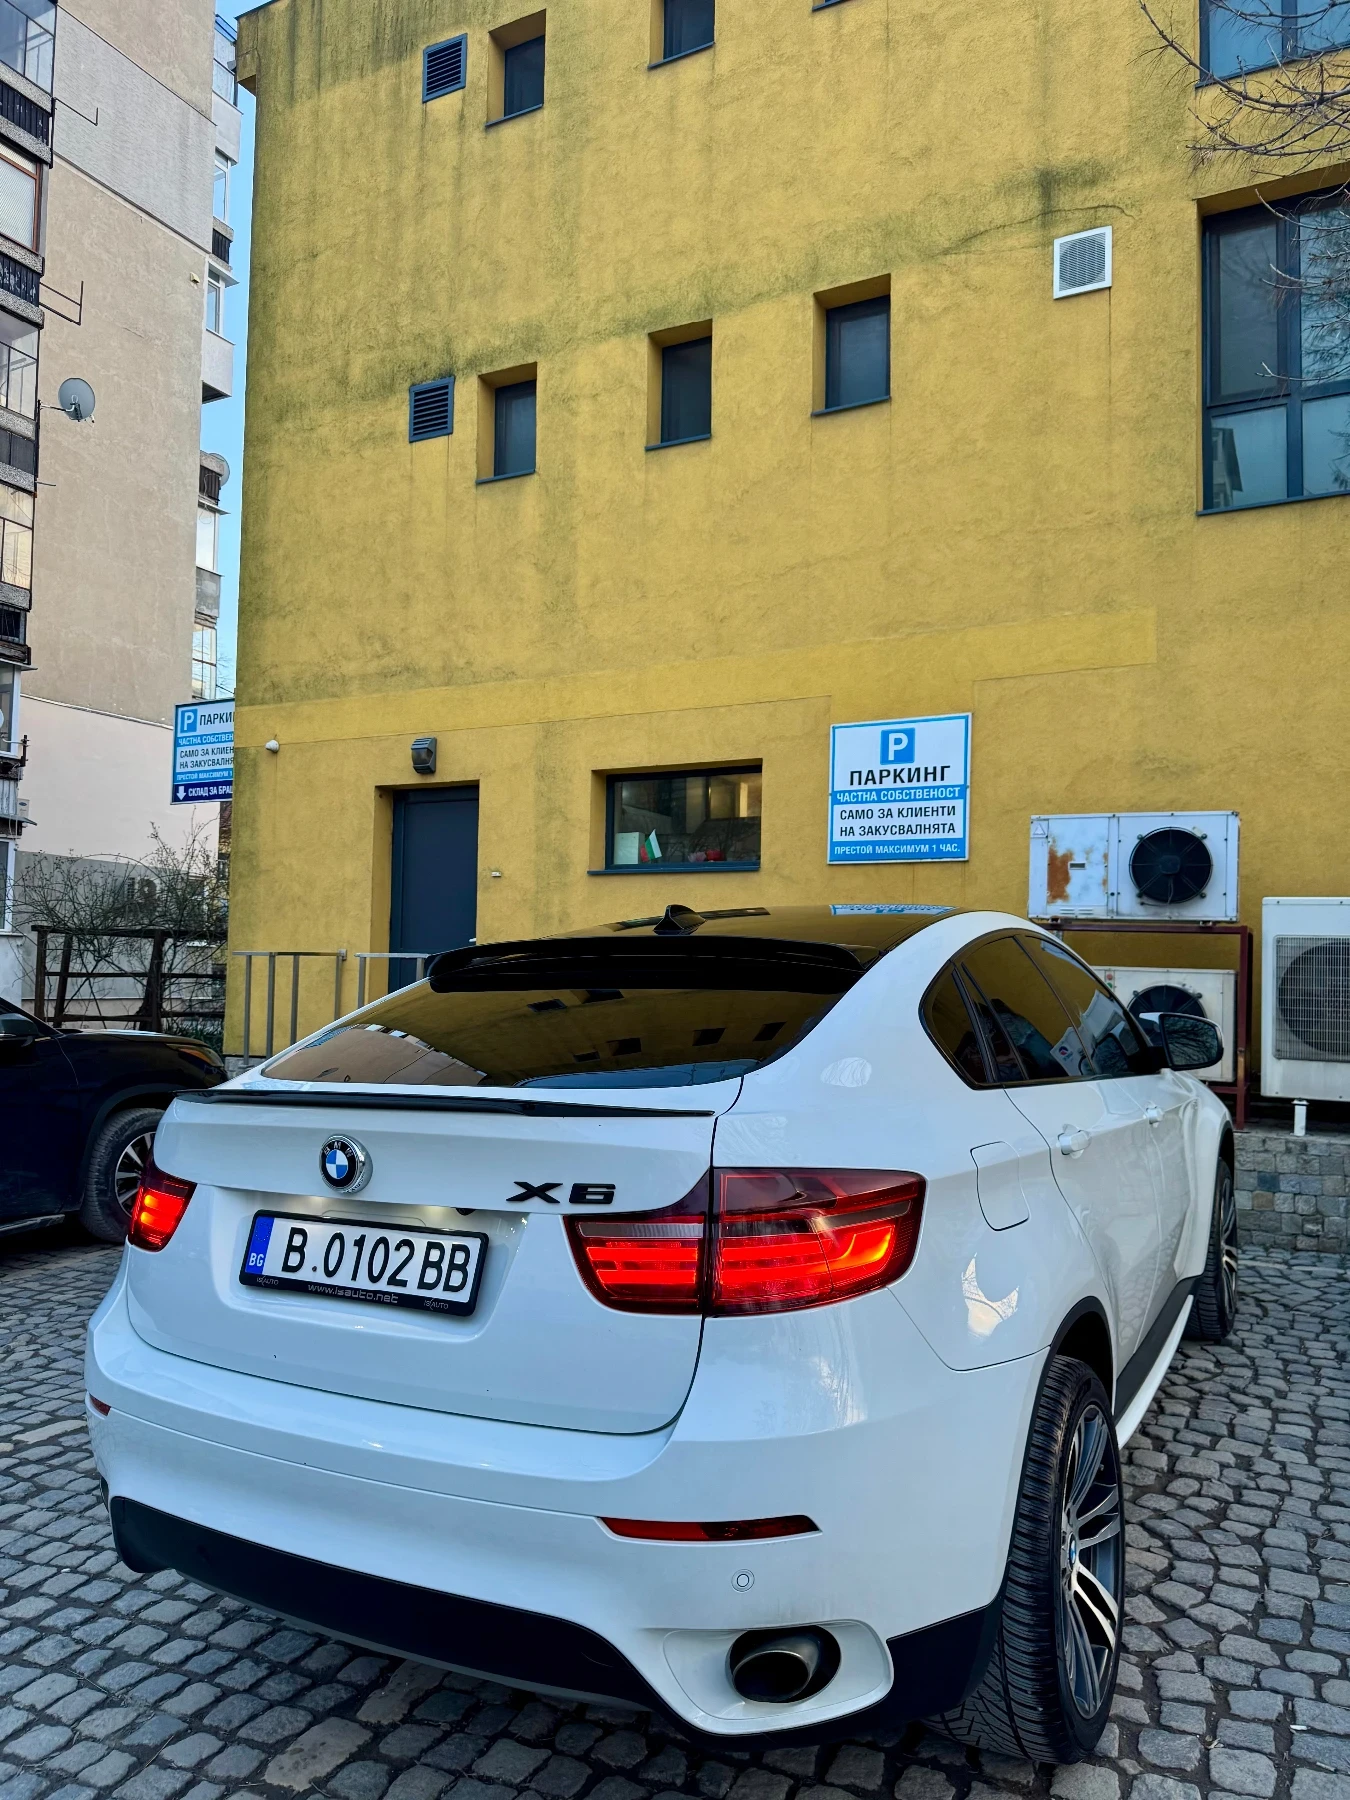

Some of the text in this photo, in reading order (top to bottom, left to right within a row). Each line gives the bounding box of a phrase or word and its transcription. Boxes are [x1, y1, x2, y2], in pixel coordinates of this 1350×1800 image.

[183, 711, 195, 731] P
[199, 711, 235, 726] ПАРКИ
[178, 736, 201, 746] ЧАСТНА
[888, 732, 909, 761] P
[180, 749, 199, 759] САМО
[200, 748, 210, 757] ЗА
[180, 760, 189, 770] НА
[849, 765, 951, 786] ПАРКИНГ
[188, 787, 209, 797] СКЛАД
[209, 786, 218, 795] ЗА
[836, 787, 961, 803] ЧАСТНА СОБСТВЕНОСТ
[840, 805, 956, 821] САМО ЗА КЛИЕНТИ
[839, 822, 956, 837] НА ЗАКУСВАЛНЯТА
[834, 843, 961, 855] ПРЕСТОЙ МАКСИМУМ 1 ЧАС.
[323, 1140, 354, 1158] BMW
[505, 1181, 616, 1204] X6
[248, 1252, 264, 1267] BG
[307, 1284, 399, 1305] www.isauto.net
